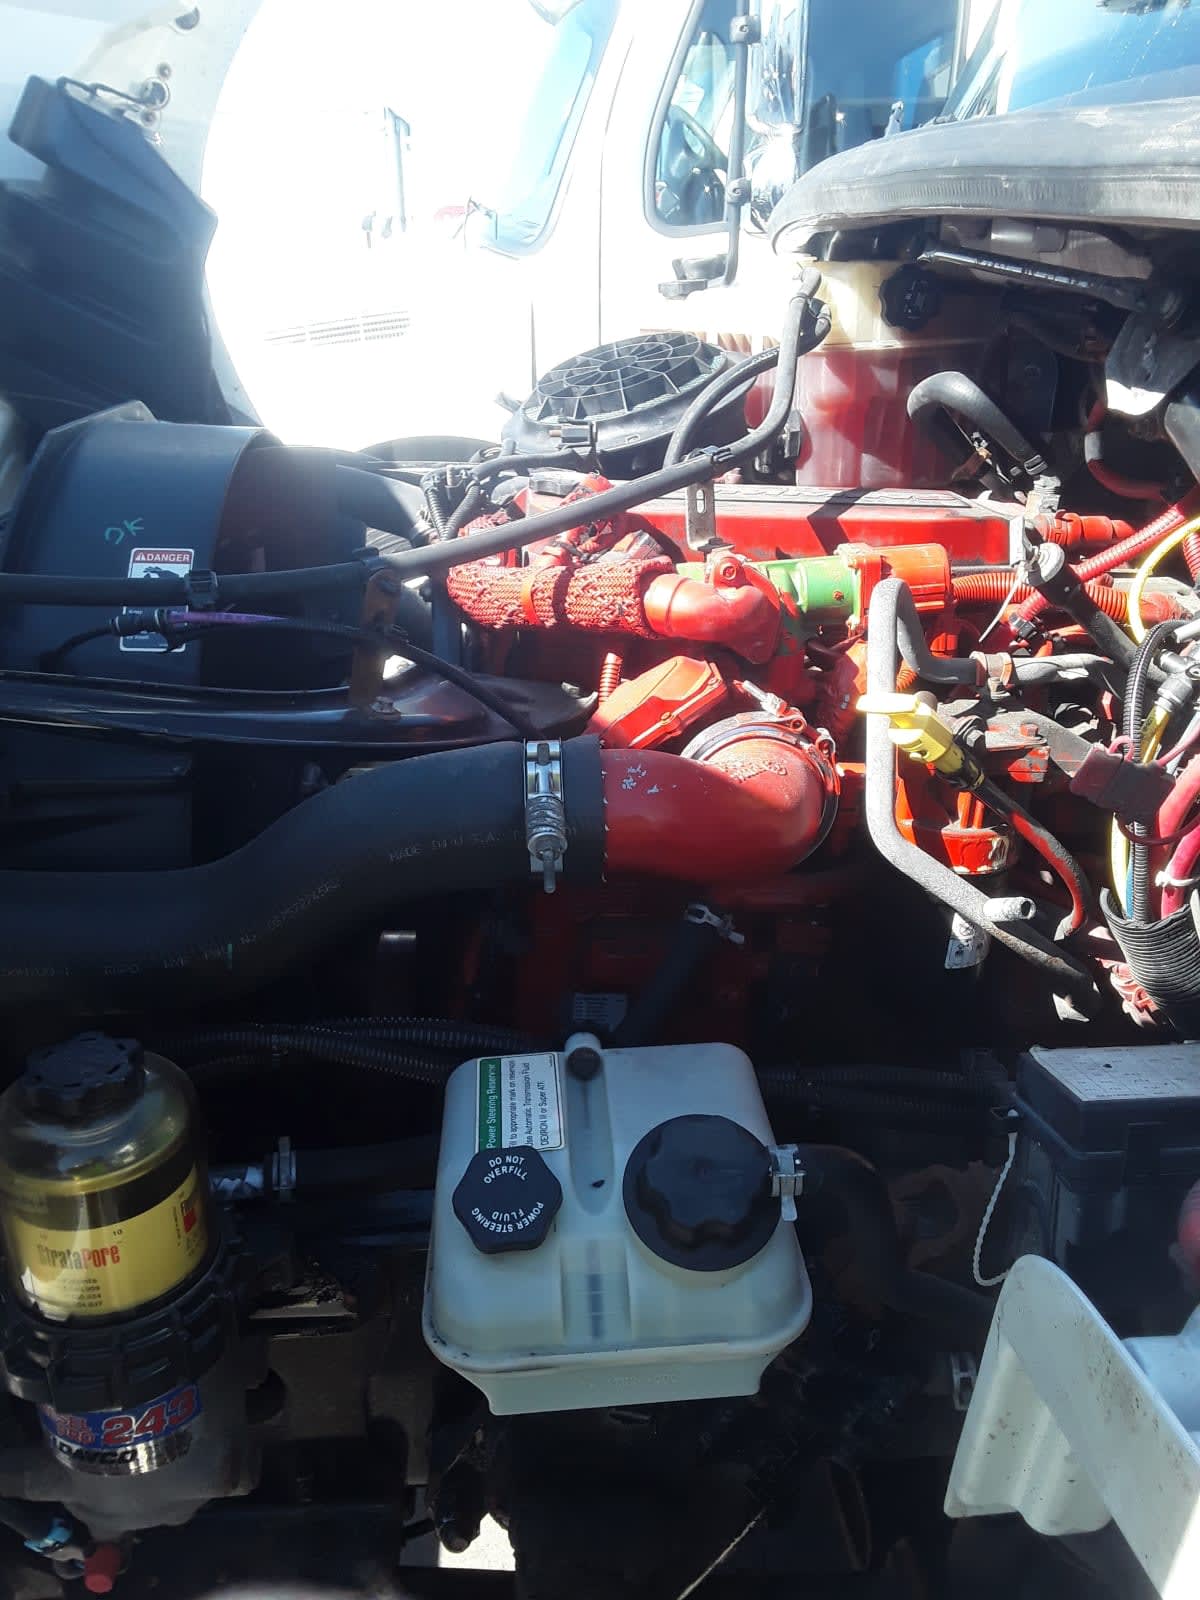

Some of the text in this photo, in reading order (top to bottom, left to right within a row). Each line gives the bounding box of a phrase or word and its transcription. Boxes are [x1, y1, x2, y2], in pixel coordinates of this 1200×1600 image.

[147, 553, 190, 562] DANGER
[523, 1075, 532, 1106] Transmission
[538, 1091, 547, 1107] Super
[486, 1095, 498, 1124] Steering
[509, 1102, 518, 1133] appropriate
[524, 1107, 533, 1134] Automatic
[486, 1128, 496, 1149] Power
[540, 1120, 549, 1146] DEXRON
[483, 1165, 528, 1184] OVERFILL
[489, 1155, 525, 1168] DO NOT
[471, 1201, 544, 1233] POWER STEERING
[491, 1208, 525, 1222] FLUID
[102, 1384, 197, 1447] 243
